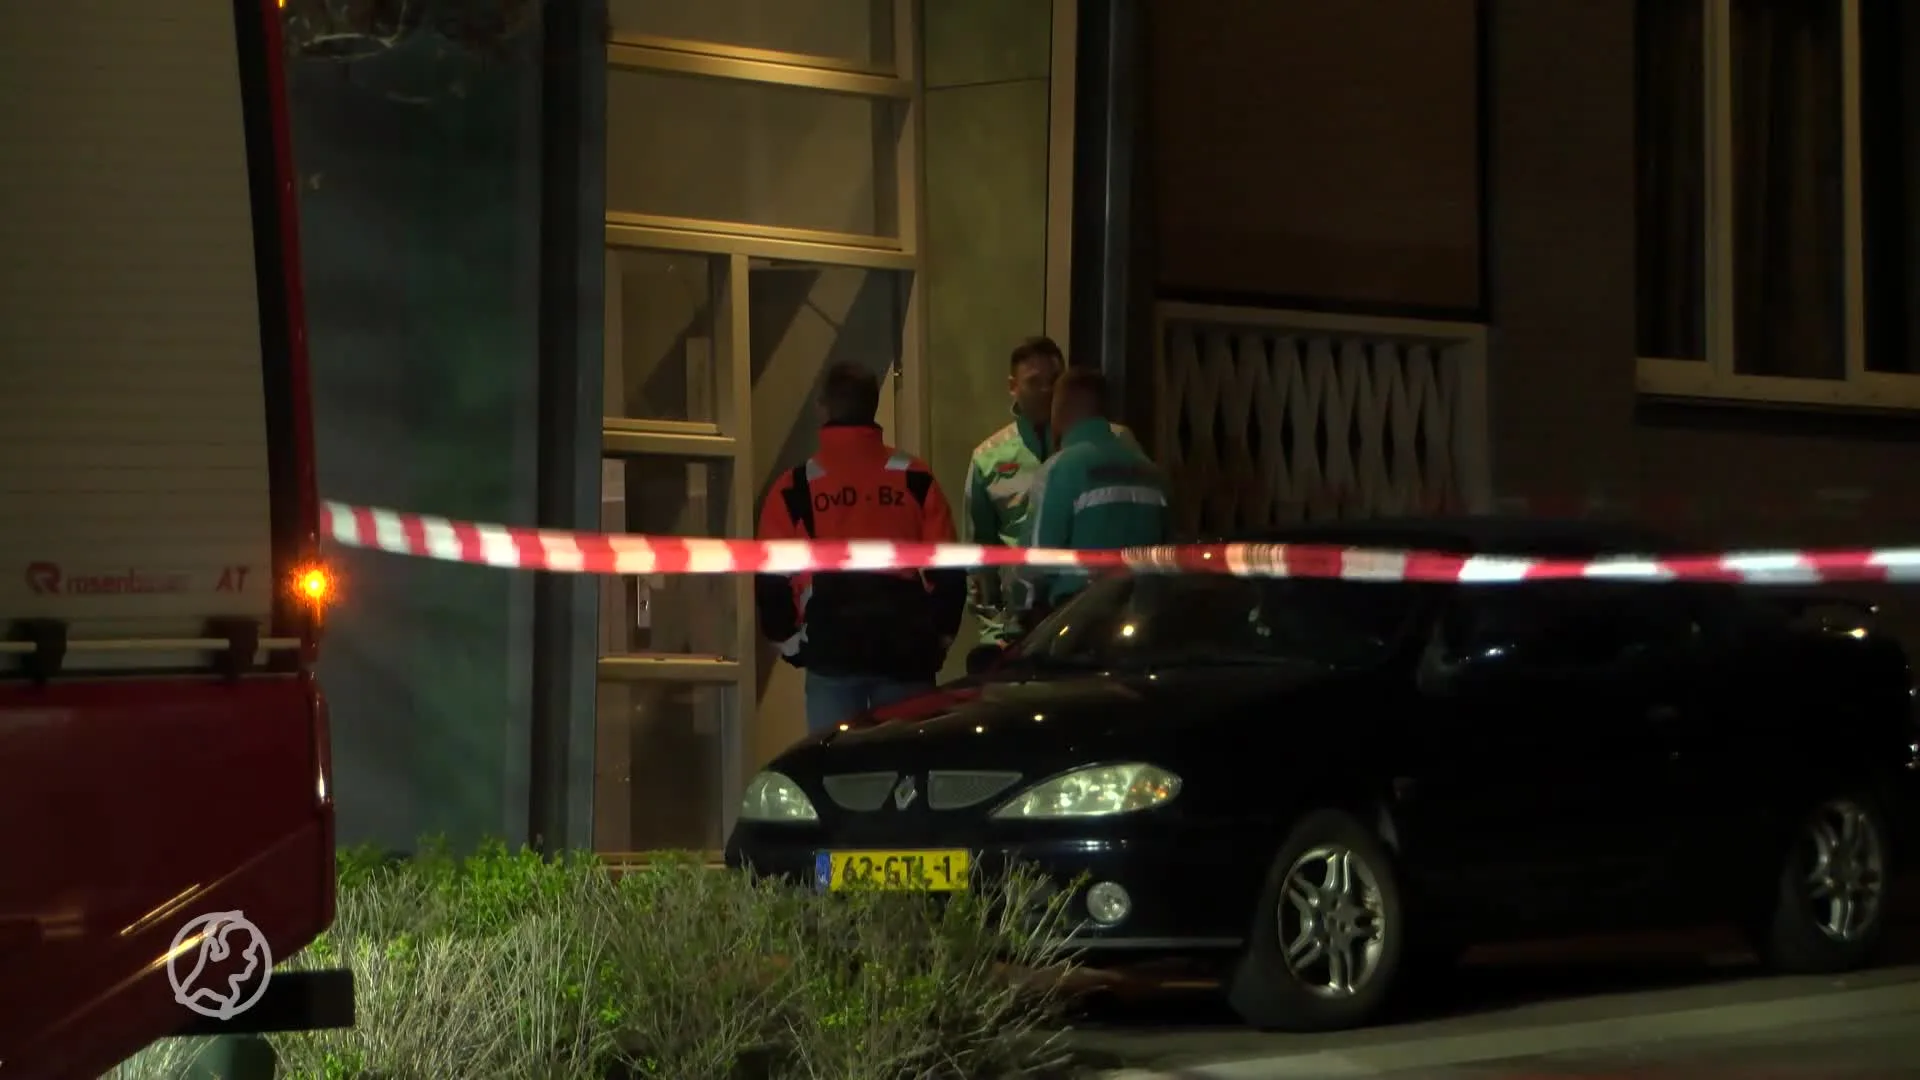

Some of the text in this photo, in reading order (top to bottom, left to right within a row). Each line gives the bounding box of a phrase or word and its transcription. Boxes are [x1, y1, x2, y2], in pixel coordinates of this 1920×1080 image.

[814, 486, 857, 512] OvD
[878, 486, 905, 506] Bz
[67, 567, 192, 594] rosenb
[215, 565, 251, 594] AT
